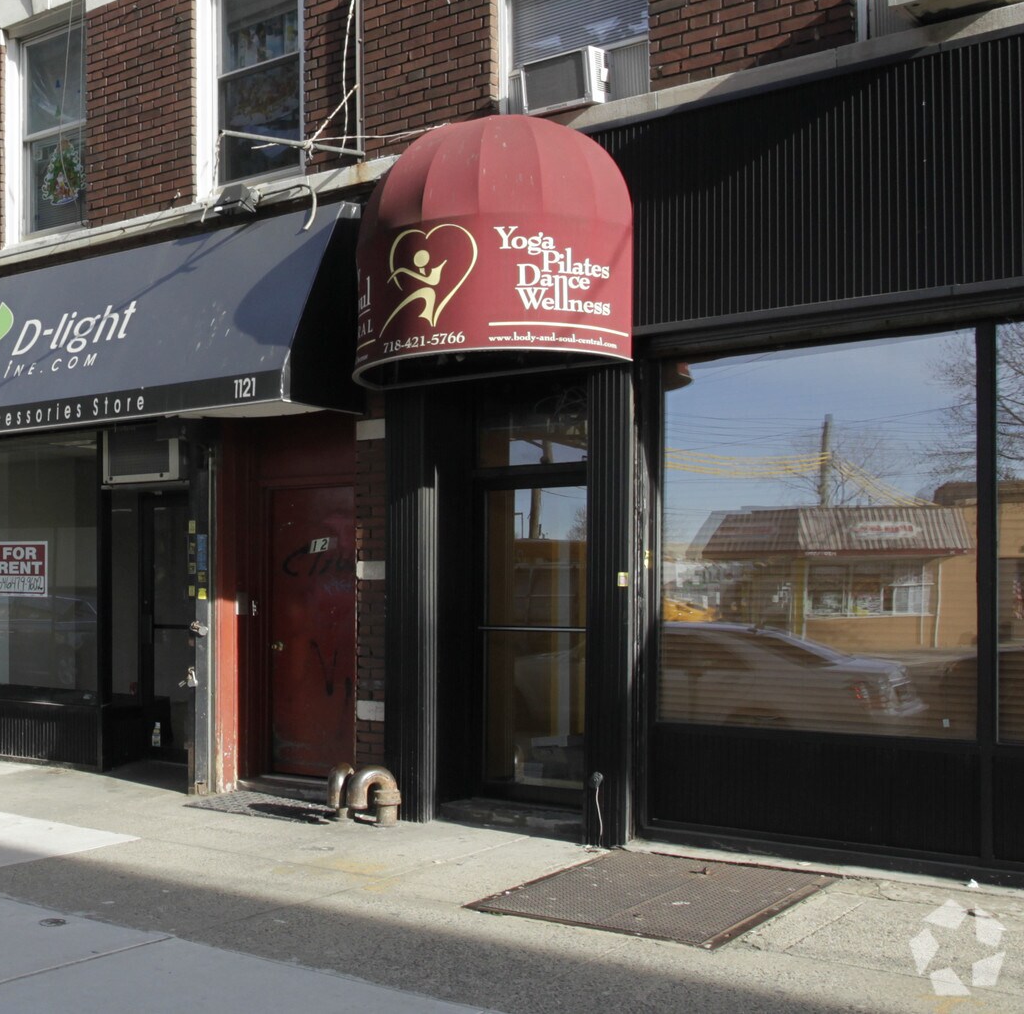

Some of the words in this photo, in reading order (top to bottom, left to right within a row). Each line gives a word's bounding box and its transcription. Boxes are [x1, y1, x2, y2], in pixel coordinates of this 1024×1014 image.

[493, 226, 555, 255] Yoga
[541, 248, 610, 279] Pilates
[516, 264, 591, 290] Dance
[515, 278, 611, 316] Wellness
[11, 300, 136, 356] D-light
[488, 331, 618, 349] www.body-and-soul-central.com
[383, 331, 465, 353] 718-421-5766
[233, 377, 256, 399] 1121
[93, 394, 144, 416] Store
[2, 547, 37, 560] FOR
